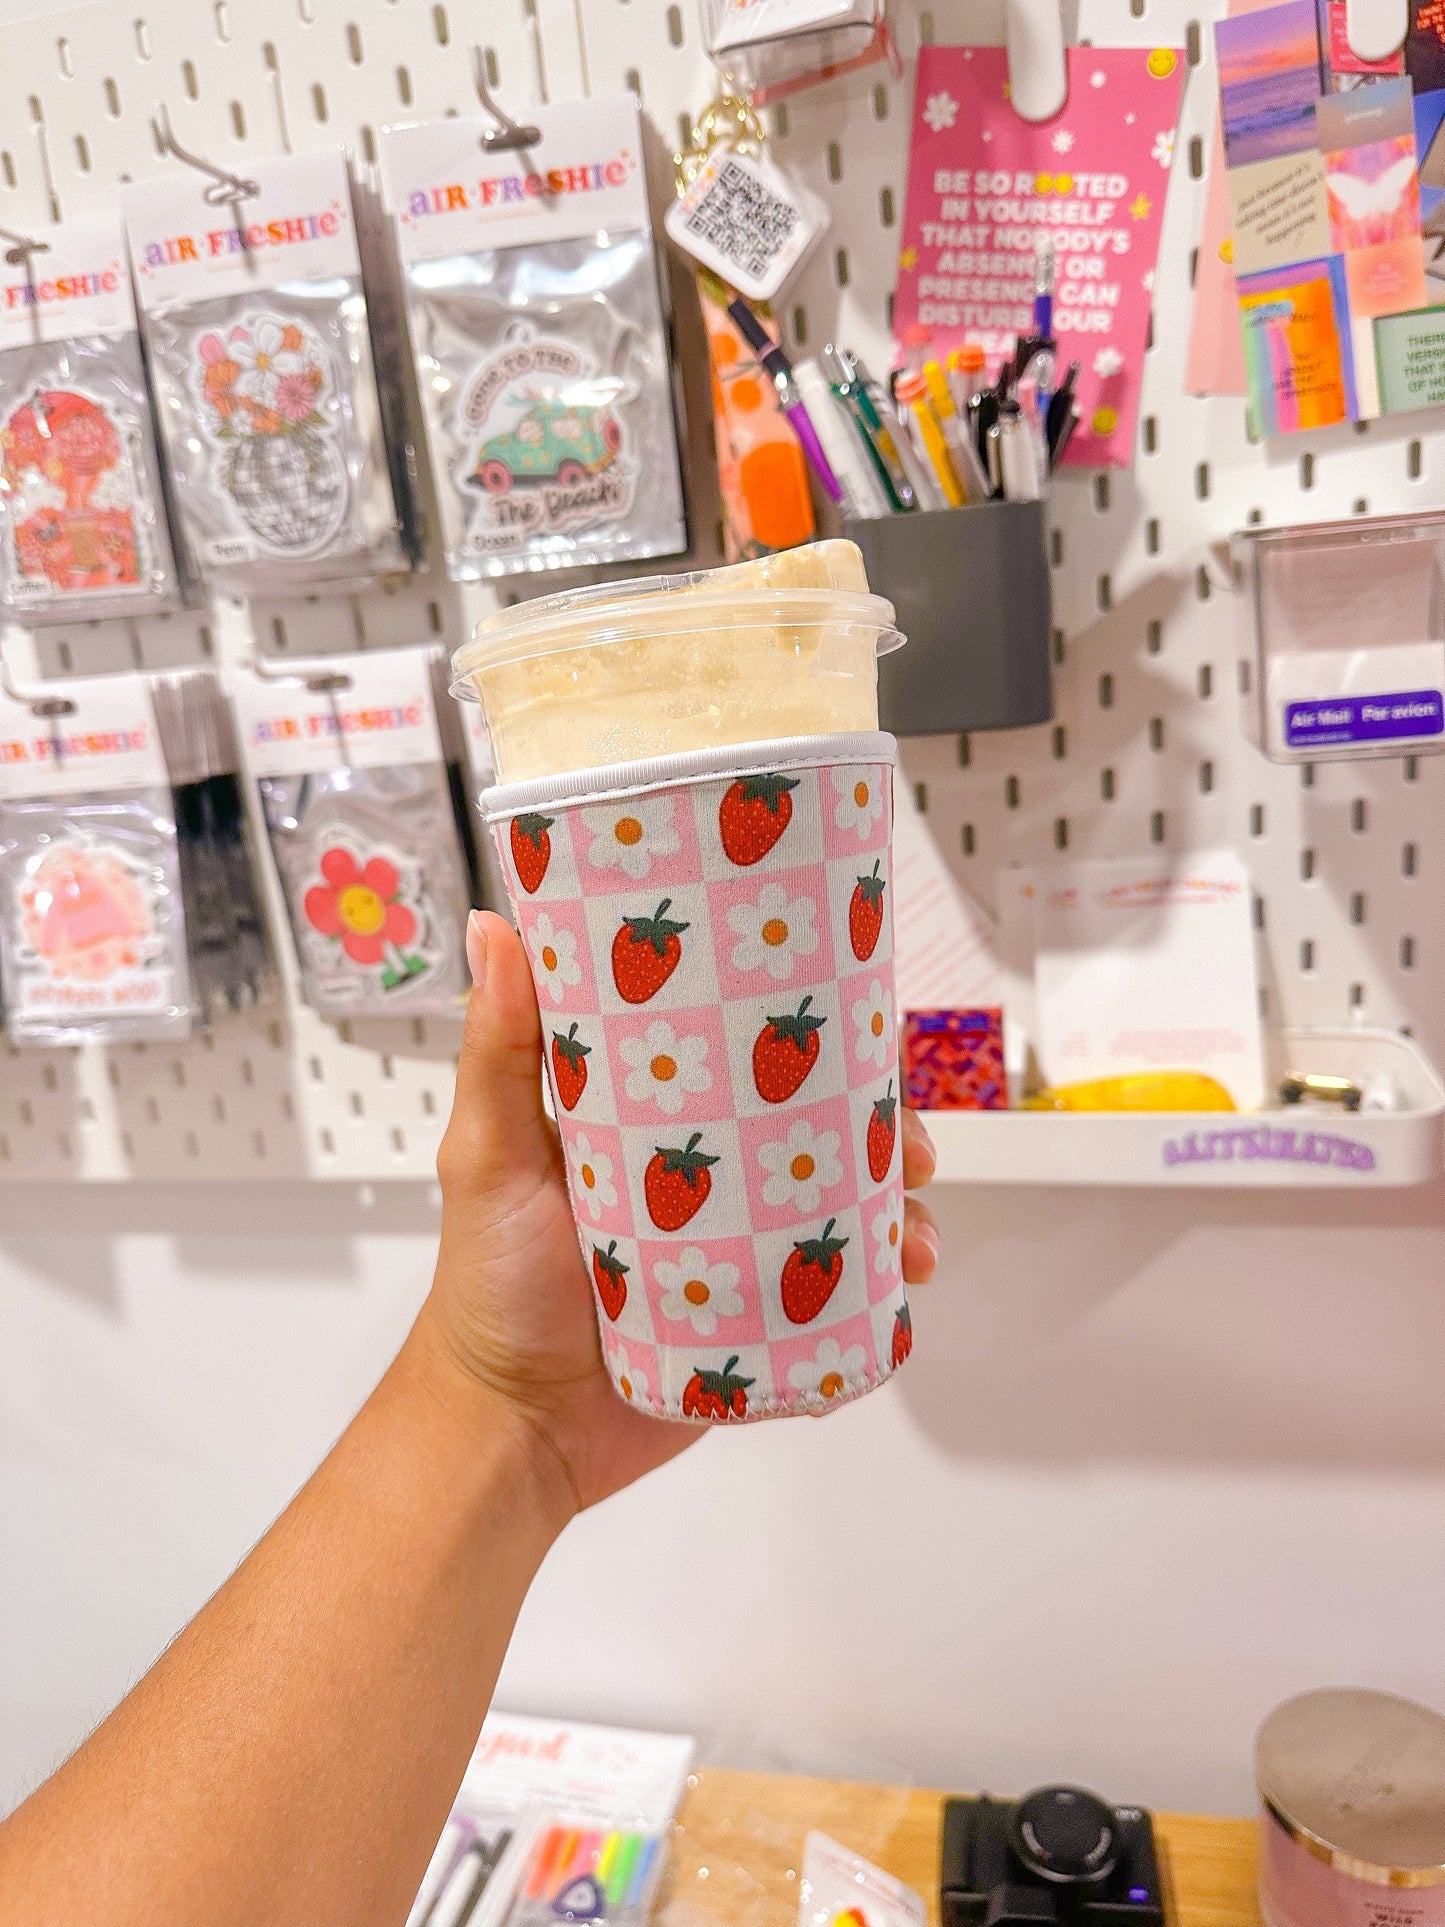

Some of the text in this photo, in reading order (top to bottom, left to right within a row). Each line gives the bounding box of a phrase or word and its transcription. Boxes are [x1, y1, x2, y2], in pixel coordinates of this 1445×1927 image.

[934, 170, 970, 194] BE
[974, 172, 1011, 195] SO
[941, 198, 1116, 225] IN YOURSELF
[920, 222, 991, 247] THAT
[1064, 255, 1106, 280] OR
[1058, 283, 1121, 308] CAN
[917, 302, 1114, 334] DISTURB OUR
[1290, 701, 1437, 729] Air Mail Par avion
